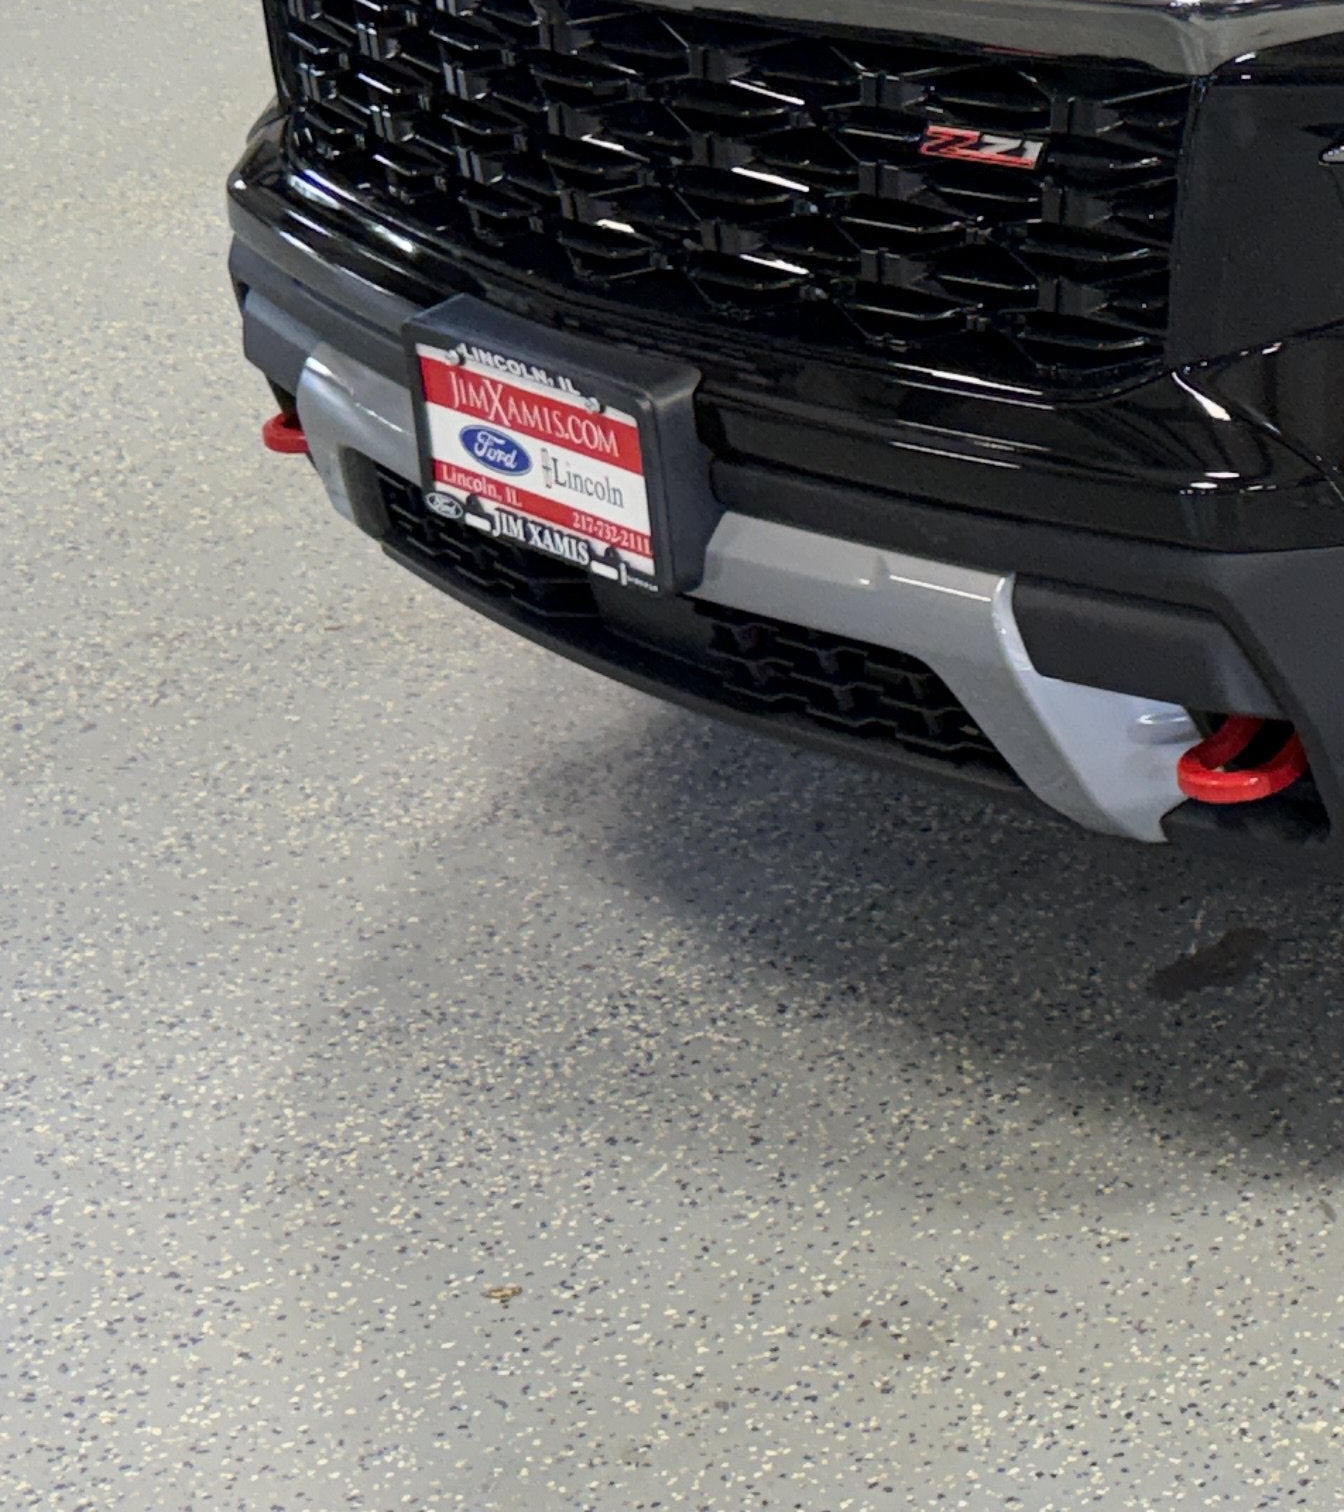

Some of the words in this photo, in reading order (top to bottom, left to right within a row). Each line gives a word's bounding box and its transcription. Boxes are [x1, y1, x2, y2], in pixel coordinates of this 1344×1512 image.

[920, 125, 1044, 170] Z71
[557, 375, 581, 397] IL
[473, 430, 518, 470] Ford
[506, 486, 523, 508] IL
[551, 457, 624, 509] Lincoln
[491, 510, 524, 542] JIM
[528, 522, 591, 567] XAMIS
